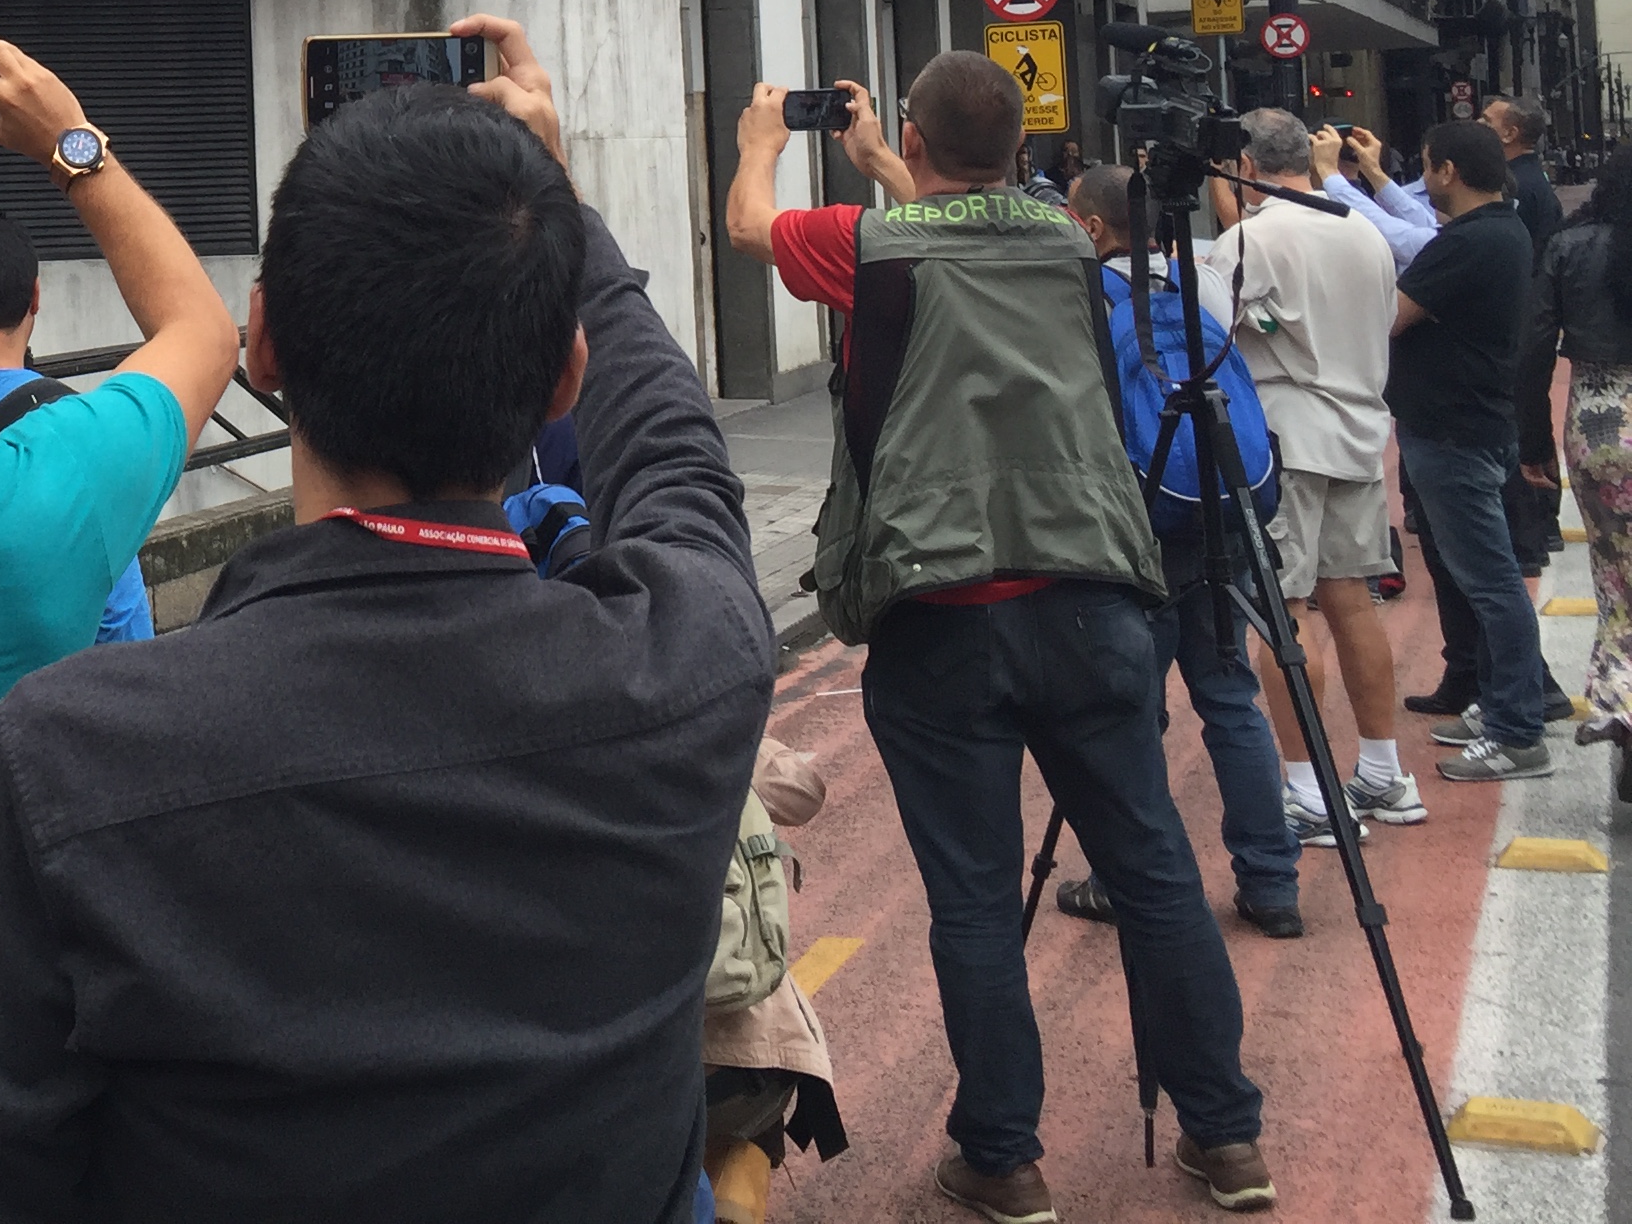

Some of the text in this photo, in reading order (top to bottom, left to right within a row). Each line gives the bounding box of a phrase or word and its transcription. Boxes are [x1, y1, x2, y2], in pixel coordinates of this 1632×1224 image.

[989, 28, 1059, 44] CICLISTA
[1024, 105, 1058, 116] VESSE
[376, 522, 405, 535] PAULO
